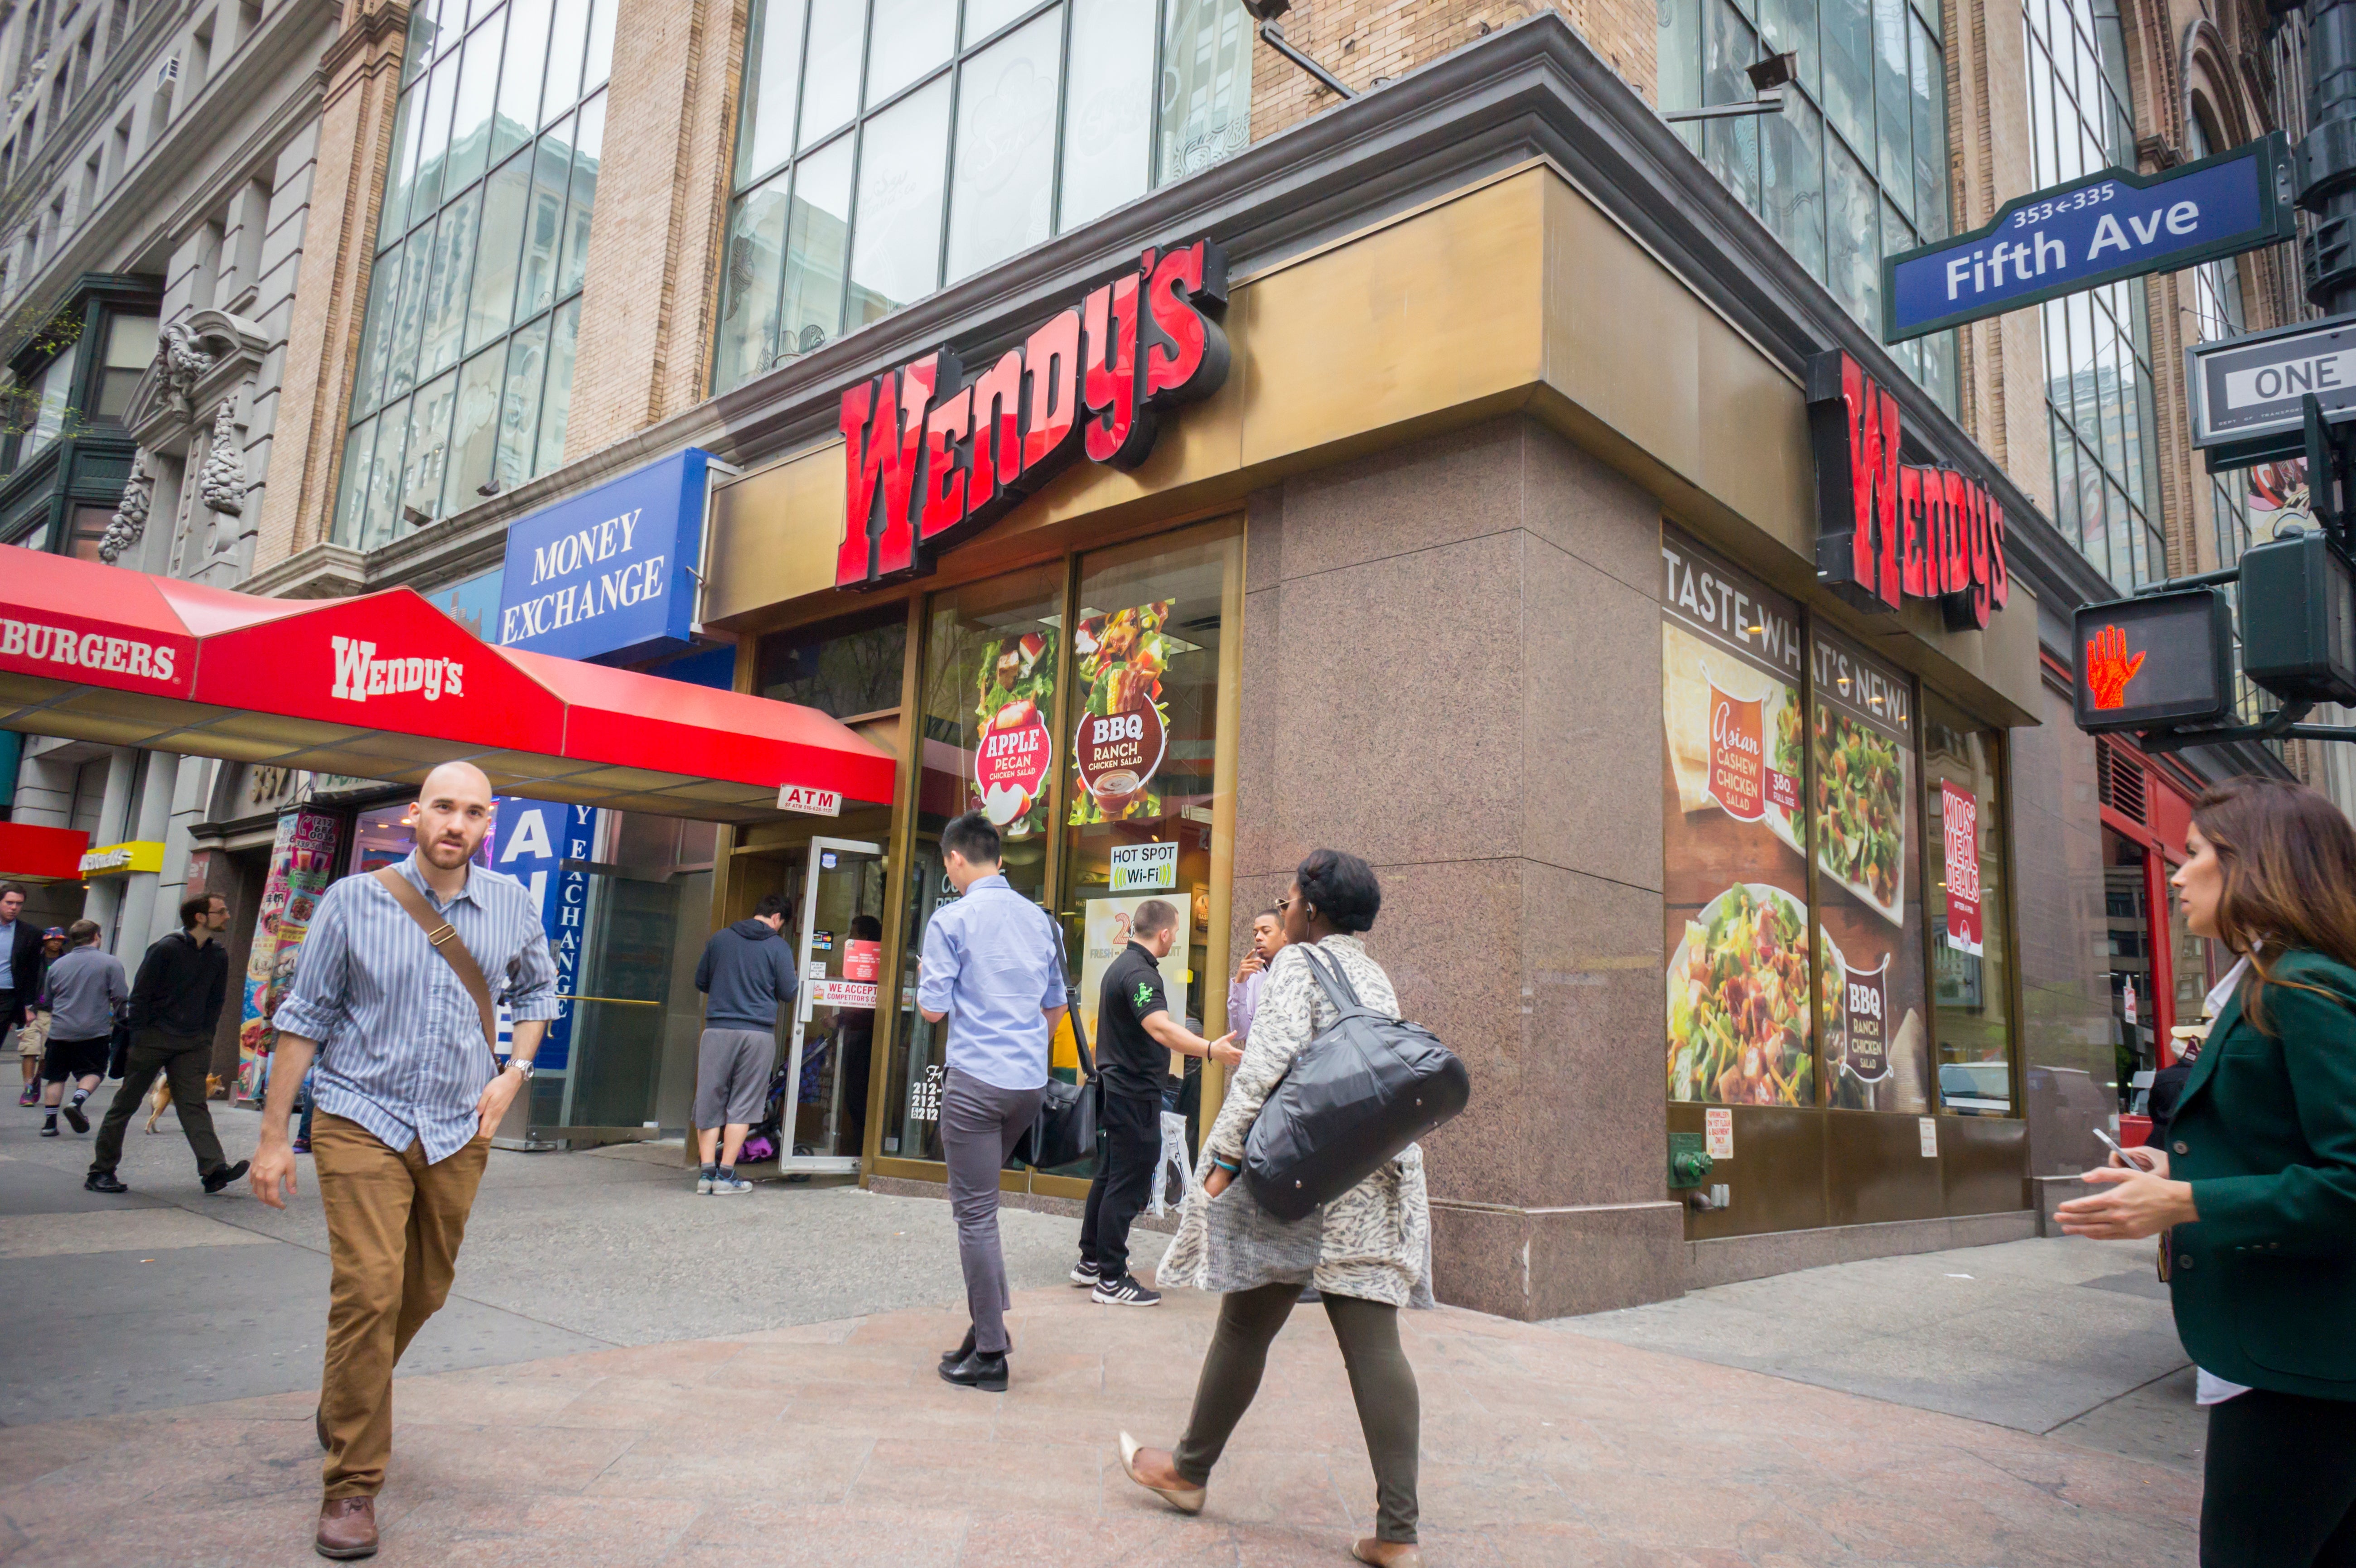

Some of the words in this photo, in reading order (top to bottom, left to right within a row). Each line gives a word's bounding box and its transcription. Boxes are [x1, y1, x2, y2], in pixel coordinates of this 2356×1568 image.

[2014, 203, 2052, 227] 353
[2074, 183, 2115, 209] 335
[1946, 231, 2066, 300] Fifth
[2086, 200, 2199, 261] Ave
[2255, 356, 2341, 398] ONE
[531, 509, 642, 585] MONEY
[501, 555, 664, 645] EXCHANGE
[0, 618, 175, 680] BURGERS
[1662, 546, 1750, 643] TASTE
[1856, 663, 1907, 730] NEW!
[1093, 714, 1143, 744] BBQ
[1714, 701, 1760, 755] Asian
[987, 729, 1039, 757] APPLE
[1094, 742, 1137, 761] RANCH
[990, 770, 1015, 780] CHICKEN
[1017, 767, 1036, 777] SALAD
[995, 754, 1031, 771] PECAN
[1088, 760, 1118, 771] CHICKEN
[1120, 756, 1142, 767] SALAD
[1717, 748, 1757, 777] CASHEW
[1717, 769, 1758, 798] CHICKEN
[1773, 773, 1790, 792] 380
[788, 789, 833, 807] ATM
[1726, 791, 1749, 811] SALAD
[1114, 849, 1138, 863] HOT
[1141, 847, 1175, 860] SPOT
[1946, 828, 1978, 874] MEAL
[1127, 867, 1159, 883] Wi-Fi
[1947, 863, 1979, 903] DEALS
[1090, 948, 1113, 959] FRESH
[827, 993, 869, 1002] COMPETITOR'S
[829, 983, 842, 993] WE
[845, 984, 878, 995] ACCEPT
[1849, 983, 1881, 1020] BBQ
[1854, 1018, 1878, 1036] RANCH
[1852, 1038, 1882, 1055] CHICKEN
[1860, 1058, 1876, 1069] SALAD
